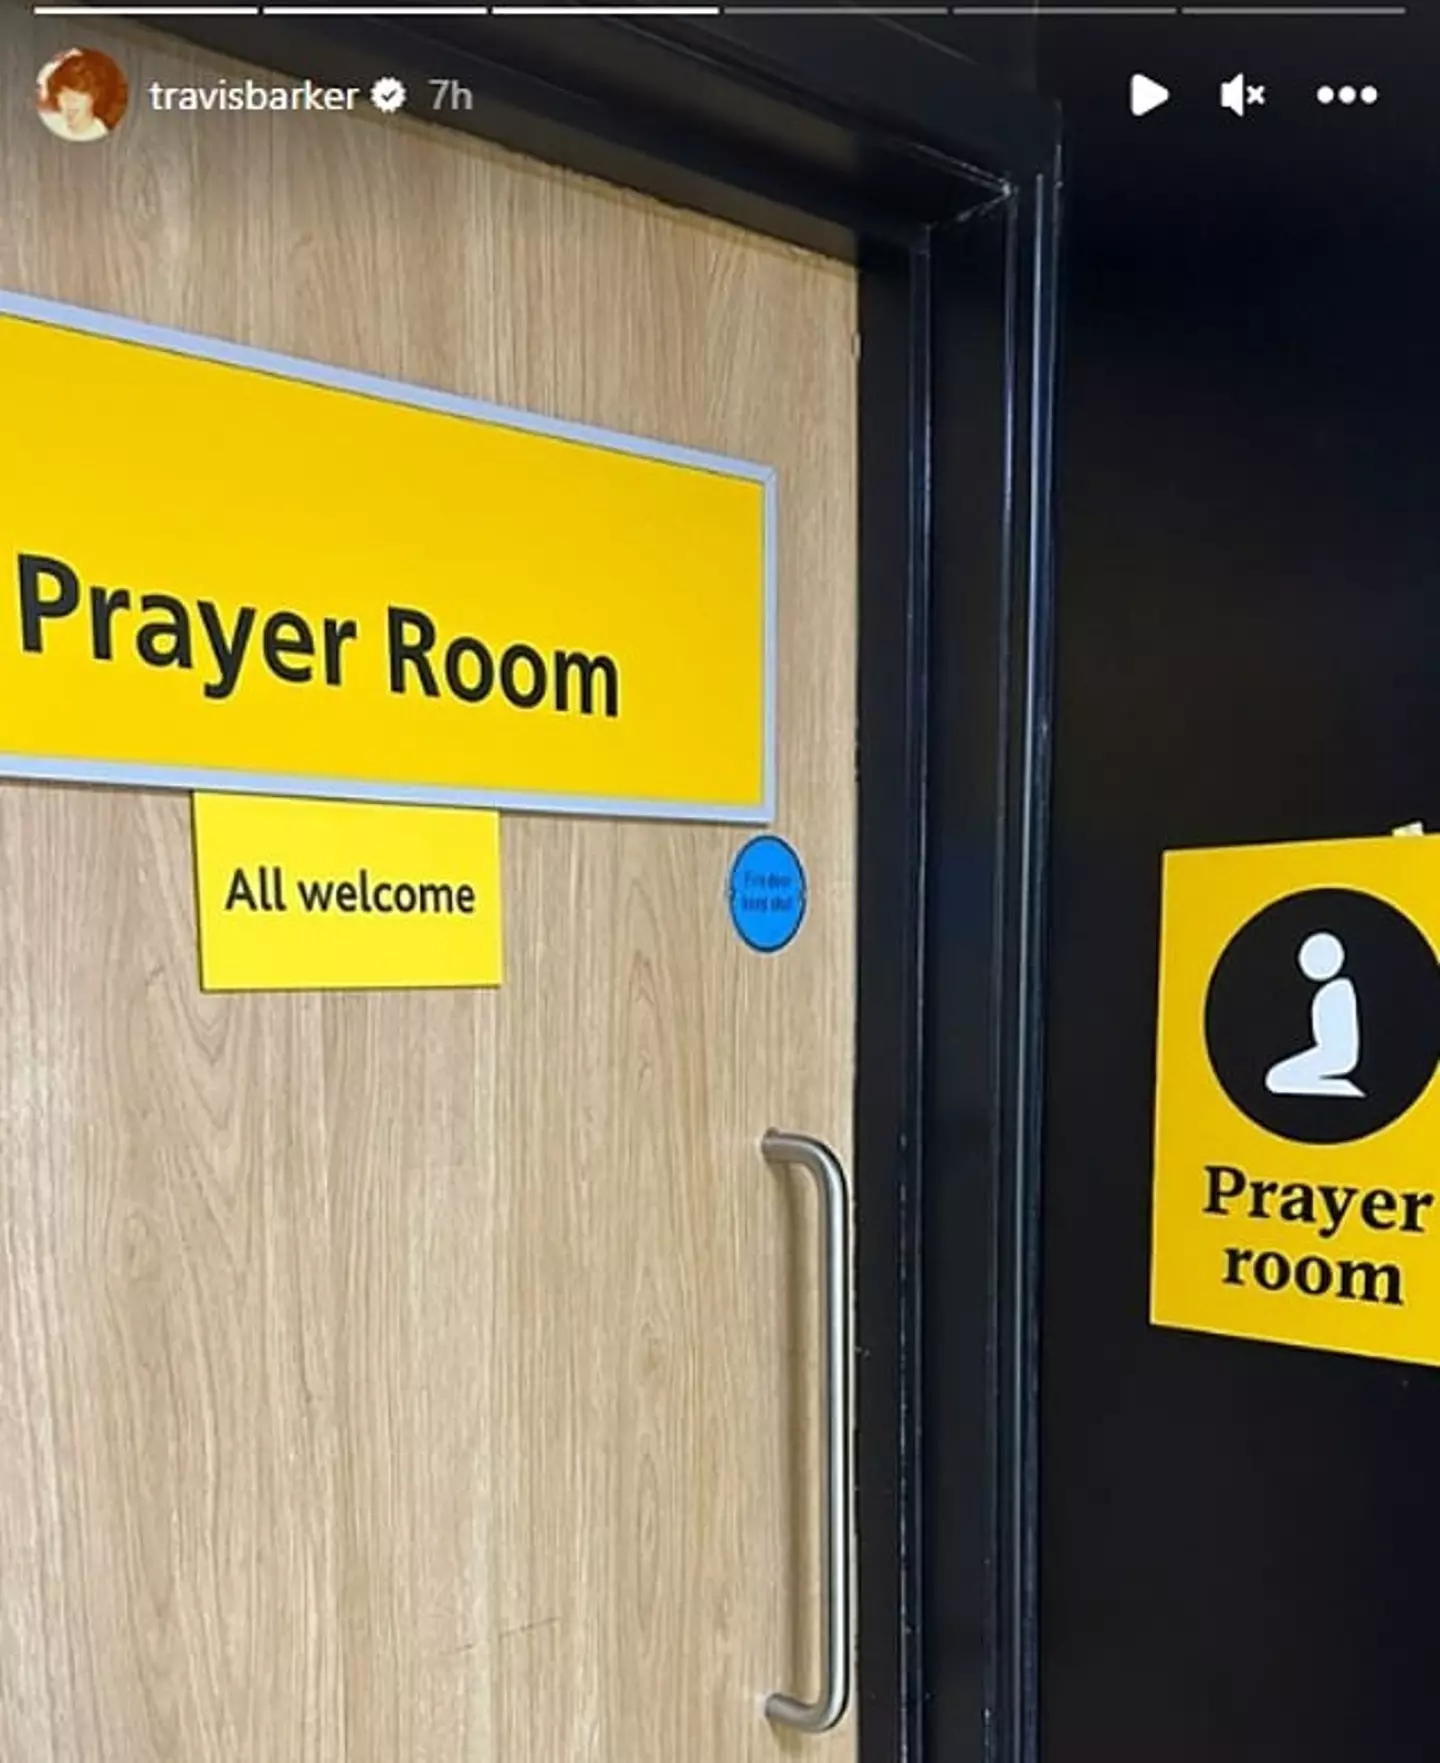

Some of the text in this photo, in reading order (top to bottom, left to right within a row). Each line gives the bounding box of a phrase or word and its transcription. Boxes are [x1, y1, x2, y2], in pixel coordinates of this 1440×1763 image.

[17, 553, 619, 718] Prayer Room
[225, 866, 476, 914] All welcome
[1203, 1165, 1434, 1239] Prayer
[1223, 1246, 1404, 1305] room
